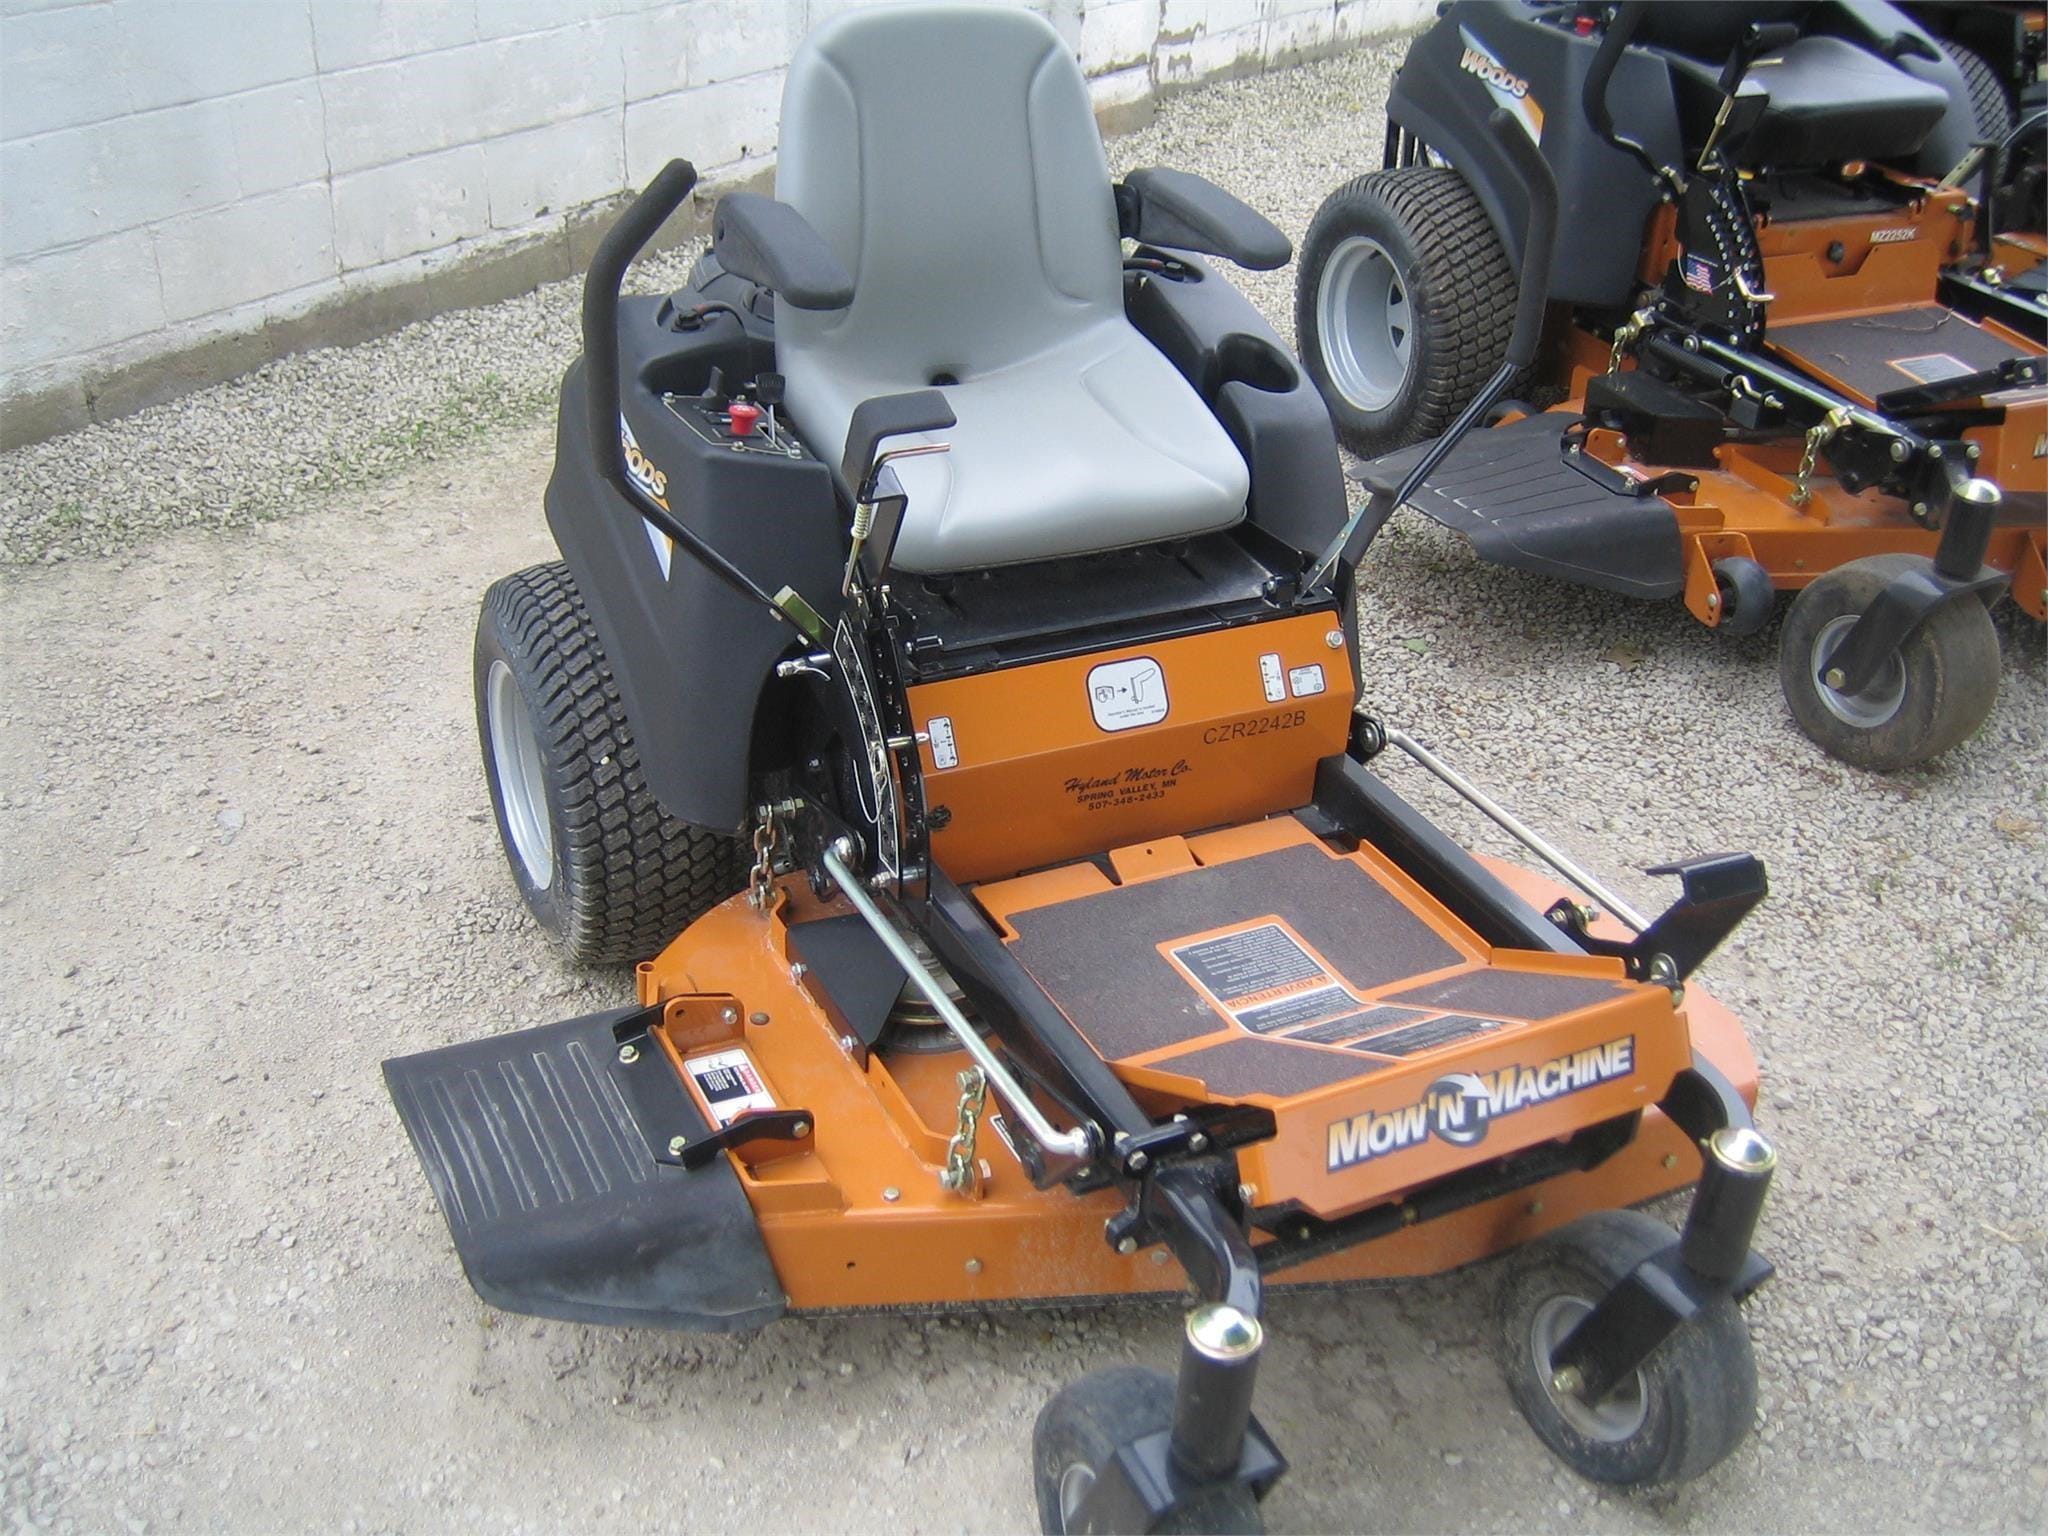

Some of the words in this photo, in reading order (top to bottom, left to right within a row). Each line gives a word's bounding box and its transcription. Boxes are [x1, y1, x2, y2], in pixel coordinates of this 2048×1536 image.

[1460, 47, 1529, 98] WOODS
[1203, 710, 1306, 744] CZR2242B
[1064, 771, 1121, 794] Hyland
[1124, 767, 1167, 782] Motor
[1077, 790, 1114, 803] SPRING
[1162, 779, 1177, 788] MN
[1227, 978, 1314, 1008] ADVERTENCIA
